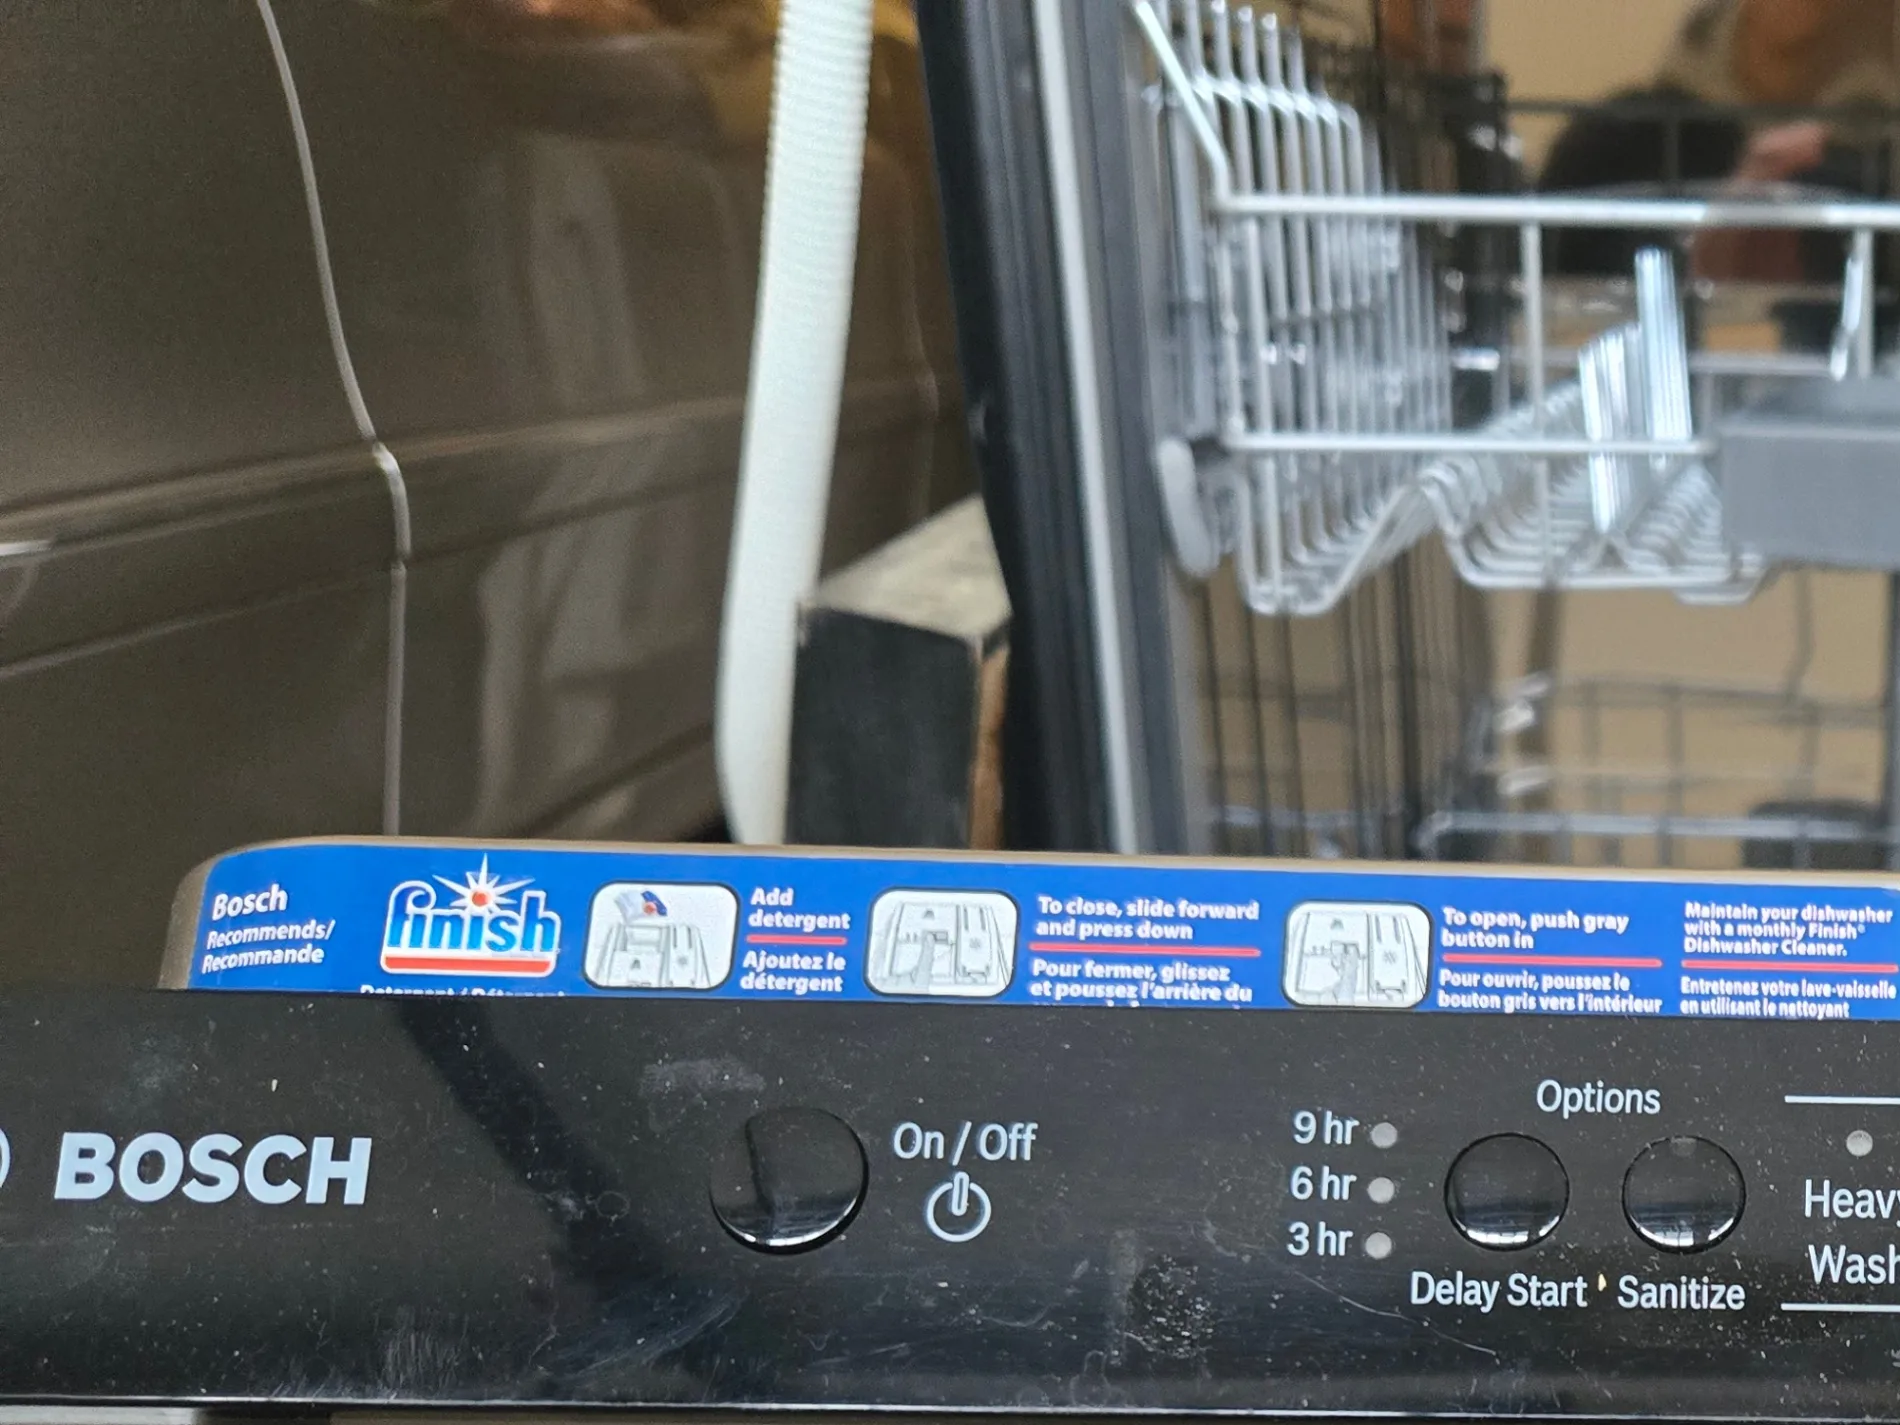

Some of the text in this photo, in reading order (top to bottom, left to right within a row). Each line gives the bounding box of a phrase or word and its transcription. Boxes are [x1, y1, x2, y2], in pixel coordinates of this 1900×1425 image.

[212, 883, 288, 921] Bosch
[750, 886, 794, 906] Add
[1038, 895, 1260, 920] To close, slide forward
[385, 880, 562, 954] finish
[748, 908, 851, 932] detergent
[1442, 905, 1629, 935] To open, push gray
[1685, 901, 1893, 924] Maintain your dishwasher
[207, 918, 336, 950] Recommends/
[1036, 918, 1193, 941] and press down
[1441, 928, 1534, 949] button in
[1684, 920, 1721, 936] with
[1723, 923, 1735, 936] a
[1737, 921, 1806, 942] monthly
[1683, 937, 1848, 957] Dishwasher Cleaner.
[202, 947, 325, 974] Recommande
[742, 950, 846, 972] Ajoutez le
[1032, 958, 1230, 984] Pour fermer, glissez
[740, 971, 844, 995] détergent
[1030, 980, 1052, 997] et
[1055, 983, 1138, 1002] poussez
[1225, 984, 1253, 1002] du
[1439, 969, 1630, 993] Pour ouvrir, poussez le
[1680, 976, 1897, 1000] Entretenez votre lave-vaisselle
[1437, 989, 1500, 1008] bouton
[1504, 992, 1537, 1014] gris
[1539, 994, 1575, 1011] vers
[1680, 1000, 1699, 1015] en
[1763, 998, 1777, 1017] le
[1779, 1001, 1850, 1020] nettoyant
[1536, 1079, 1662, 1117] Options
[1292, 1110, 1359, 1146] 9 hr
[892, 1122, 943, 1162] On
[979, 1121, 1039, 1162] Off
[53, 1131, 373, 1207] BOSCH
[1289, 1166, 1356, 1202] 6 hr
[1286, 1220, 1354, 1257] 3 hr
[1410, 1270, 1588, 1316] Delay Start
[1616, 1275, 1746, 1311] Sanitize
